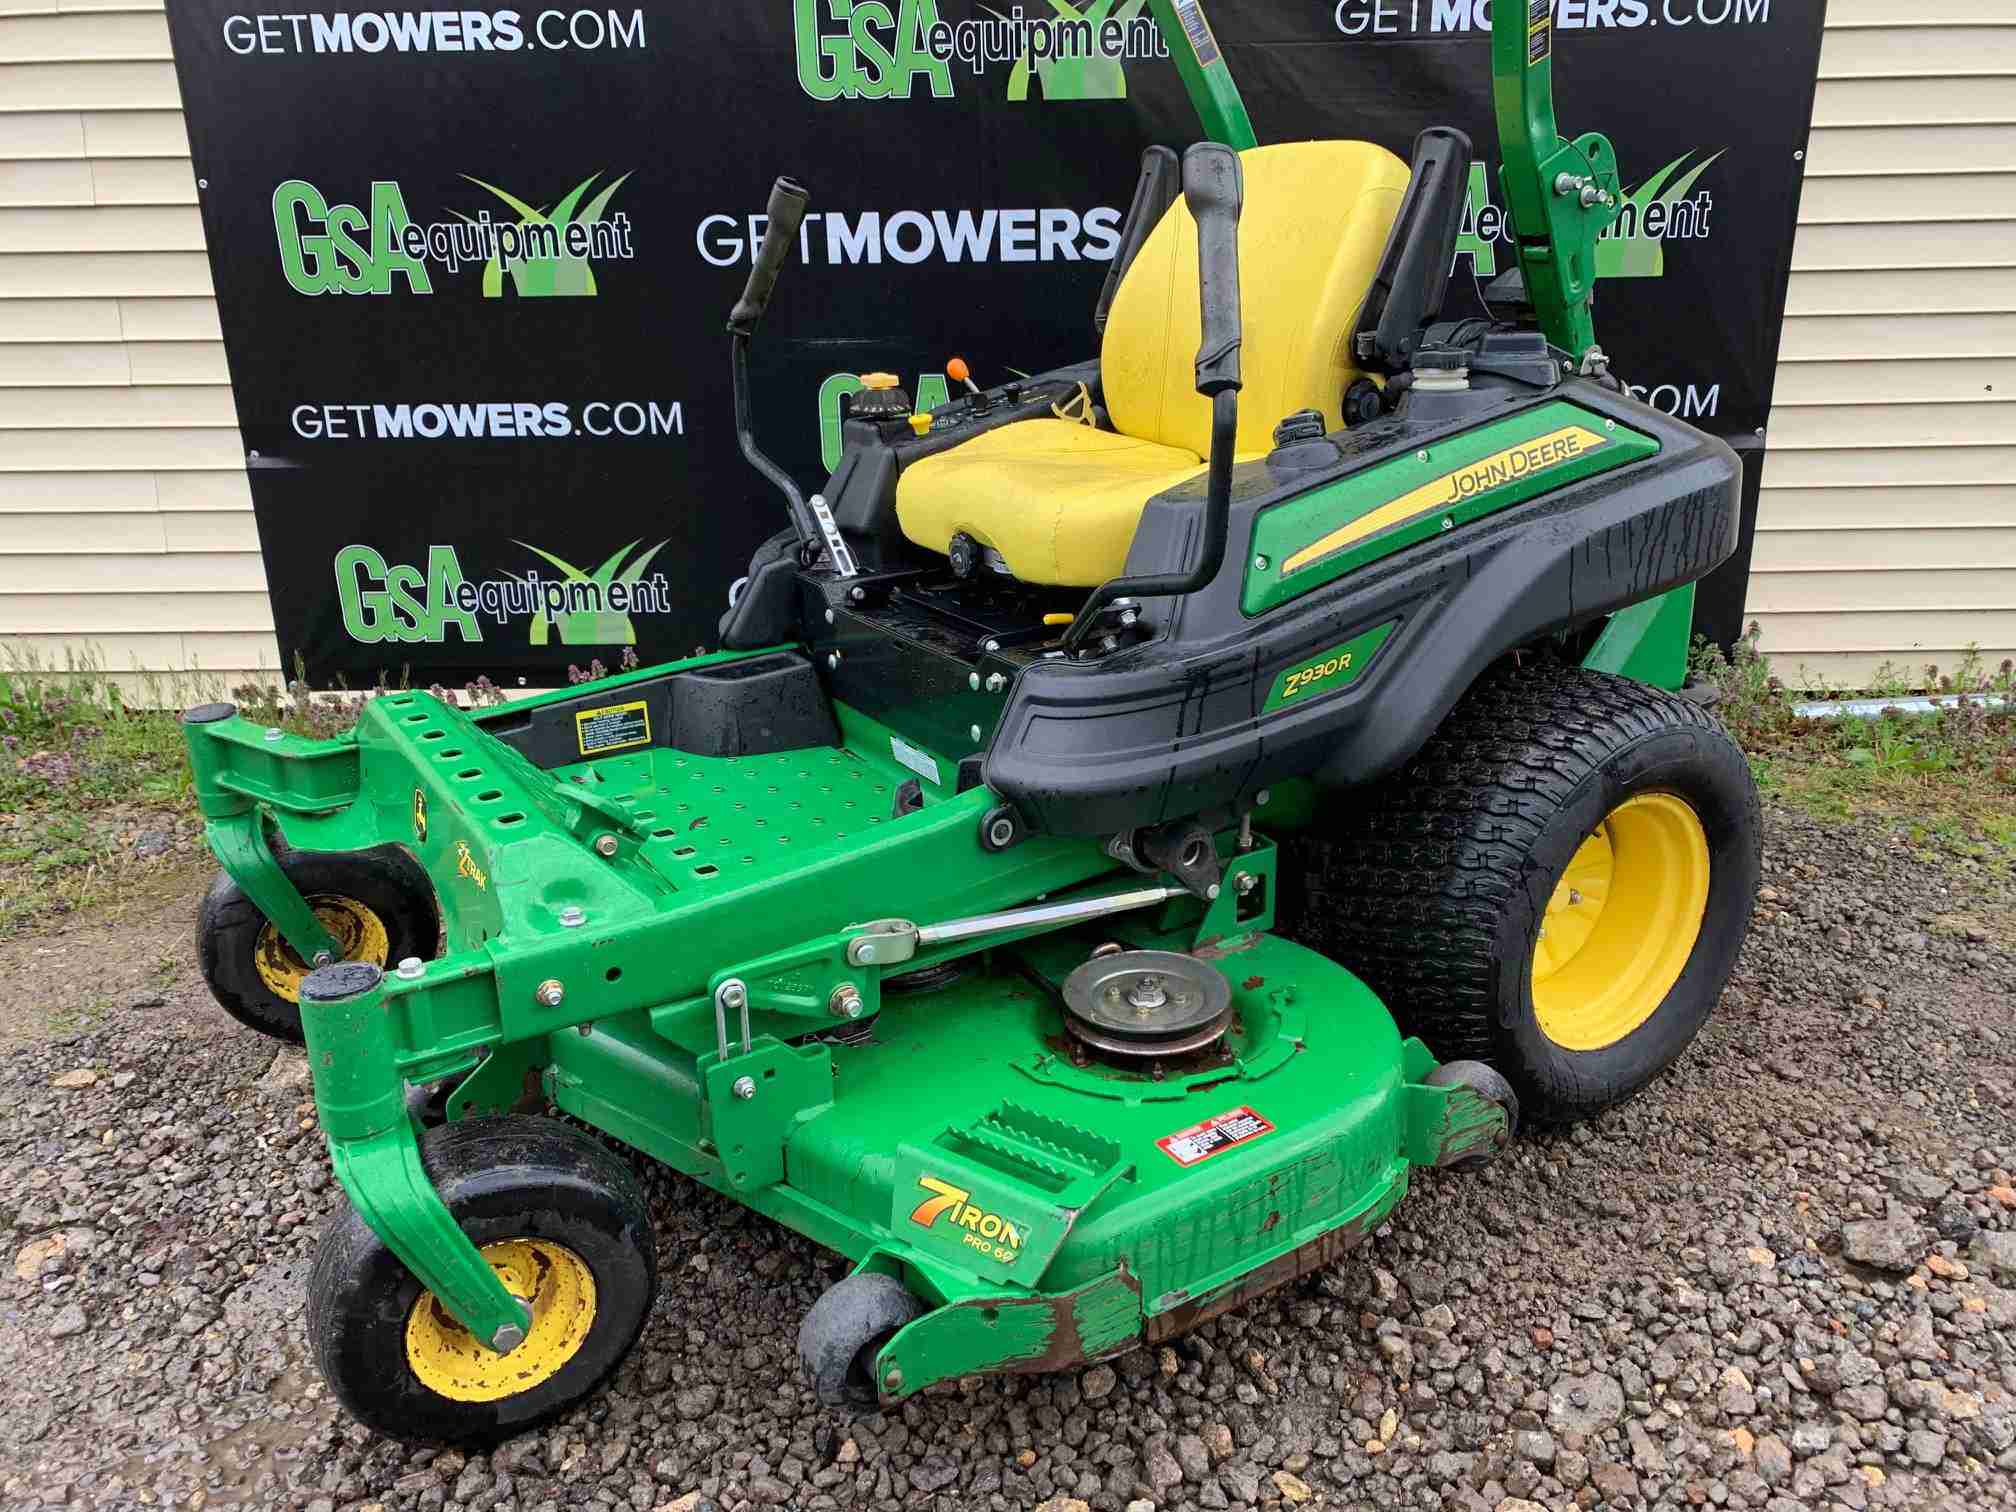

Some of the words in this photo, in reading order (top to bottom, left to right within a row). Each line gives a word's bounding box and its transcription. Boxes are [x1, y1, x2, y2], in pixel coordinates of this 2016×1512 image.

[223, 9, 647, 54] GETMOWERS.COM
[292, 401, 684, 439] GETMOWERS.COM
[1447, 461, 1507, 501] JOHN
[1509, 433, 1581, 474] DEERE
[963, 1232, 992, 1254] PRO
